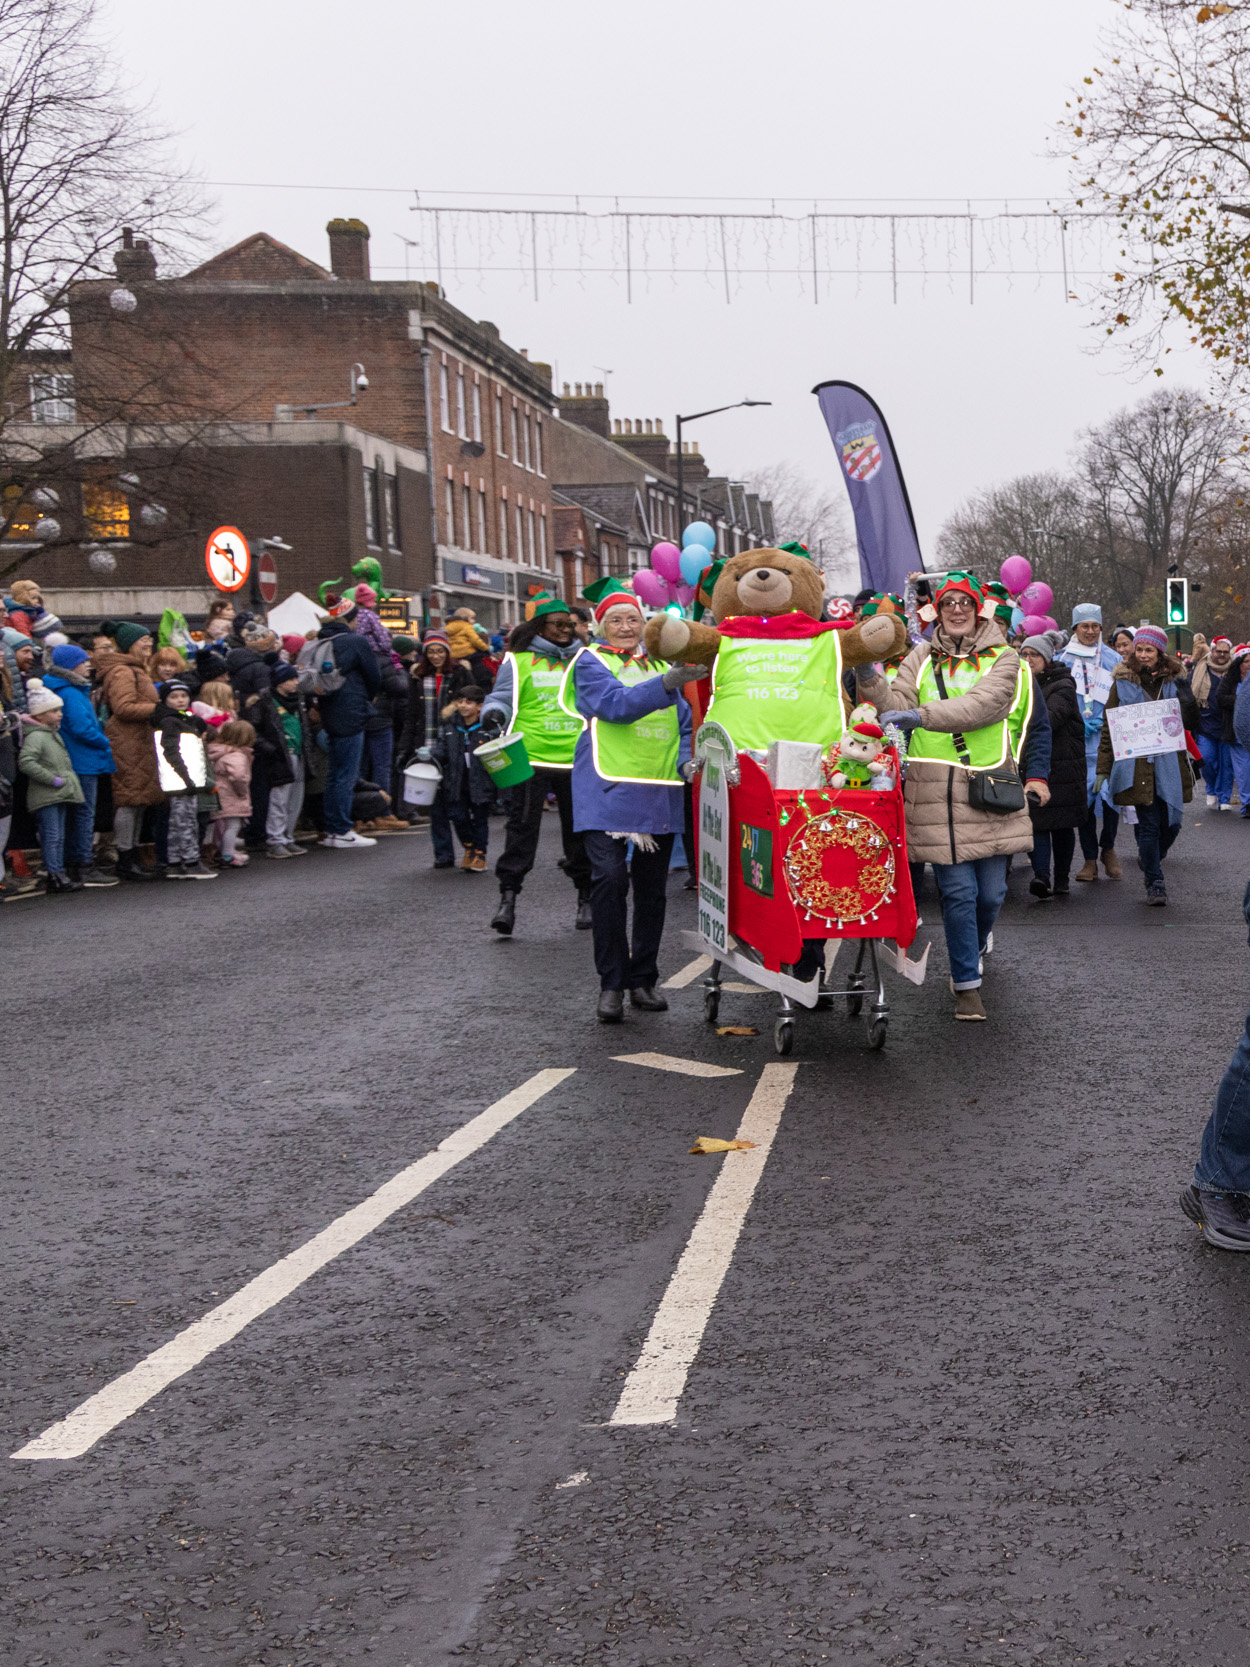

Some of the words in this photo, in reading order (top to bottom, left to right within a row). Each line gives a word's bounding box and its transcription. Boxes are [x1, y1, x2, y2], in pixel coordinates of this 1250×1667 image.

[736, 651, 776, 663] We're
[779, 651, 808, 662] here
[745, 664, 759, 673] to
[763, 664, 799, 673] listen
[746, 687, 769, 699] 116
[774, 687, 799, 700] 123
[544, 721, 561, 730] 116
[563, 721, 578, 730] 12
[635, 726, 651, 738] 116
[751, 860, 764, 890] 365
[700, 909, 711, 937] 116
[712, 919, 725, 949] 123
